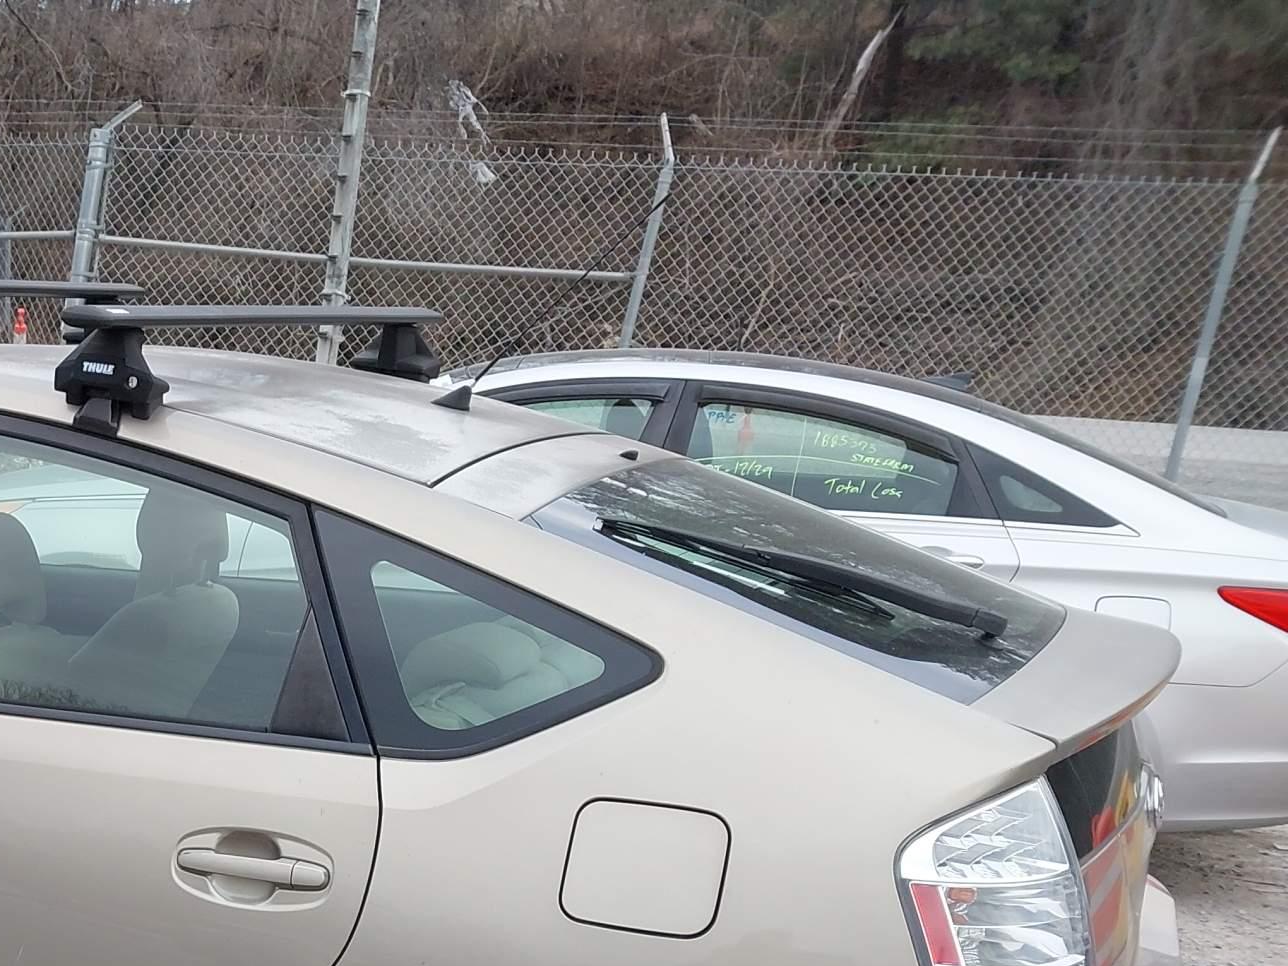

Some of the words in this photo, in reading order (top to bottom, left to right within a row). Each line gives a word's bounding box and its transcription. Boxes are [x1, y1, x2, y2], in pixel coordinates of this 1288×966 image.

[82, 361, 115, 375] THULE
[824, 477, 866, 495] Total
[871, 481, 904, 499] Loss
